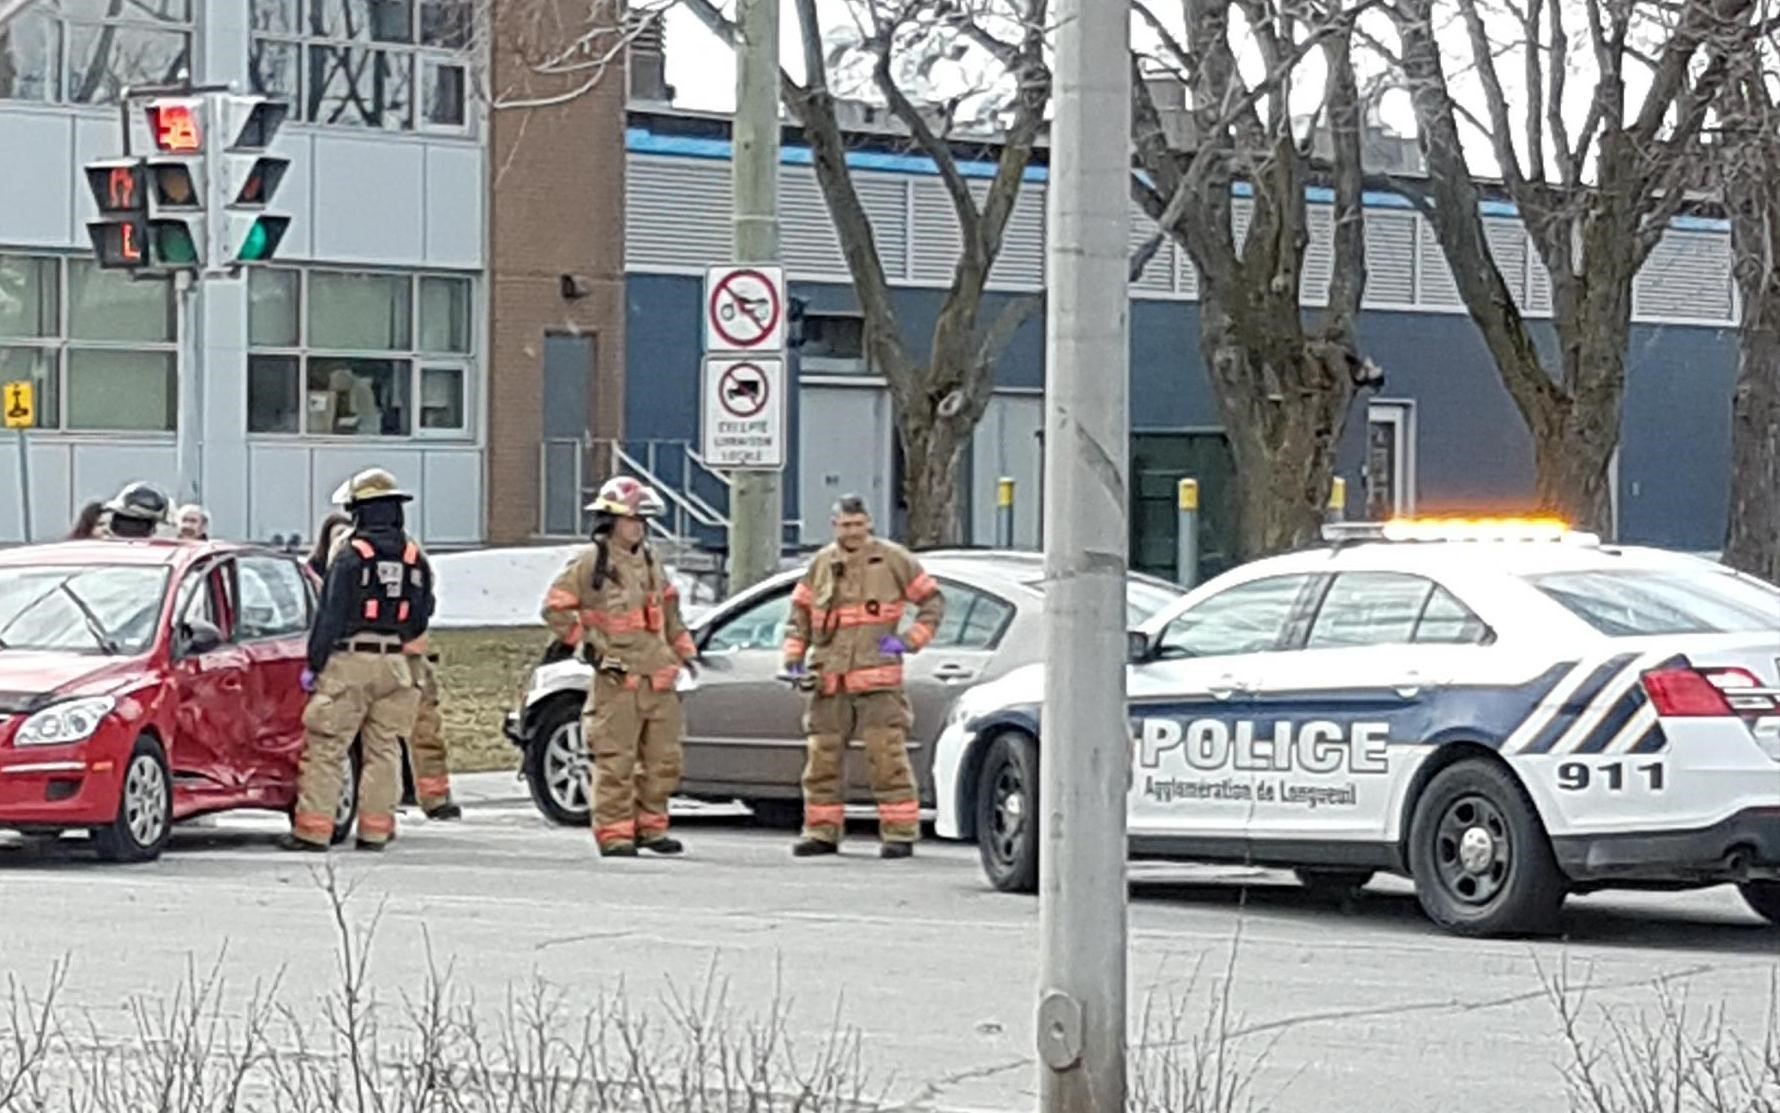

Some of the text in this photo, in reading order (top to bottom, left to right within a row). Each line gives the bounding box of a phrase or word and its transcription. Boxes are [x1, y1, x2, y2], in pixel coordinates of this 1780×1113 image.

[1140, 718, 1390, 773] POLICE
[1557, 762, 1663, 790] 911
[1257, 780, 1274, 801] de
